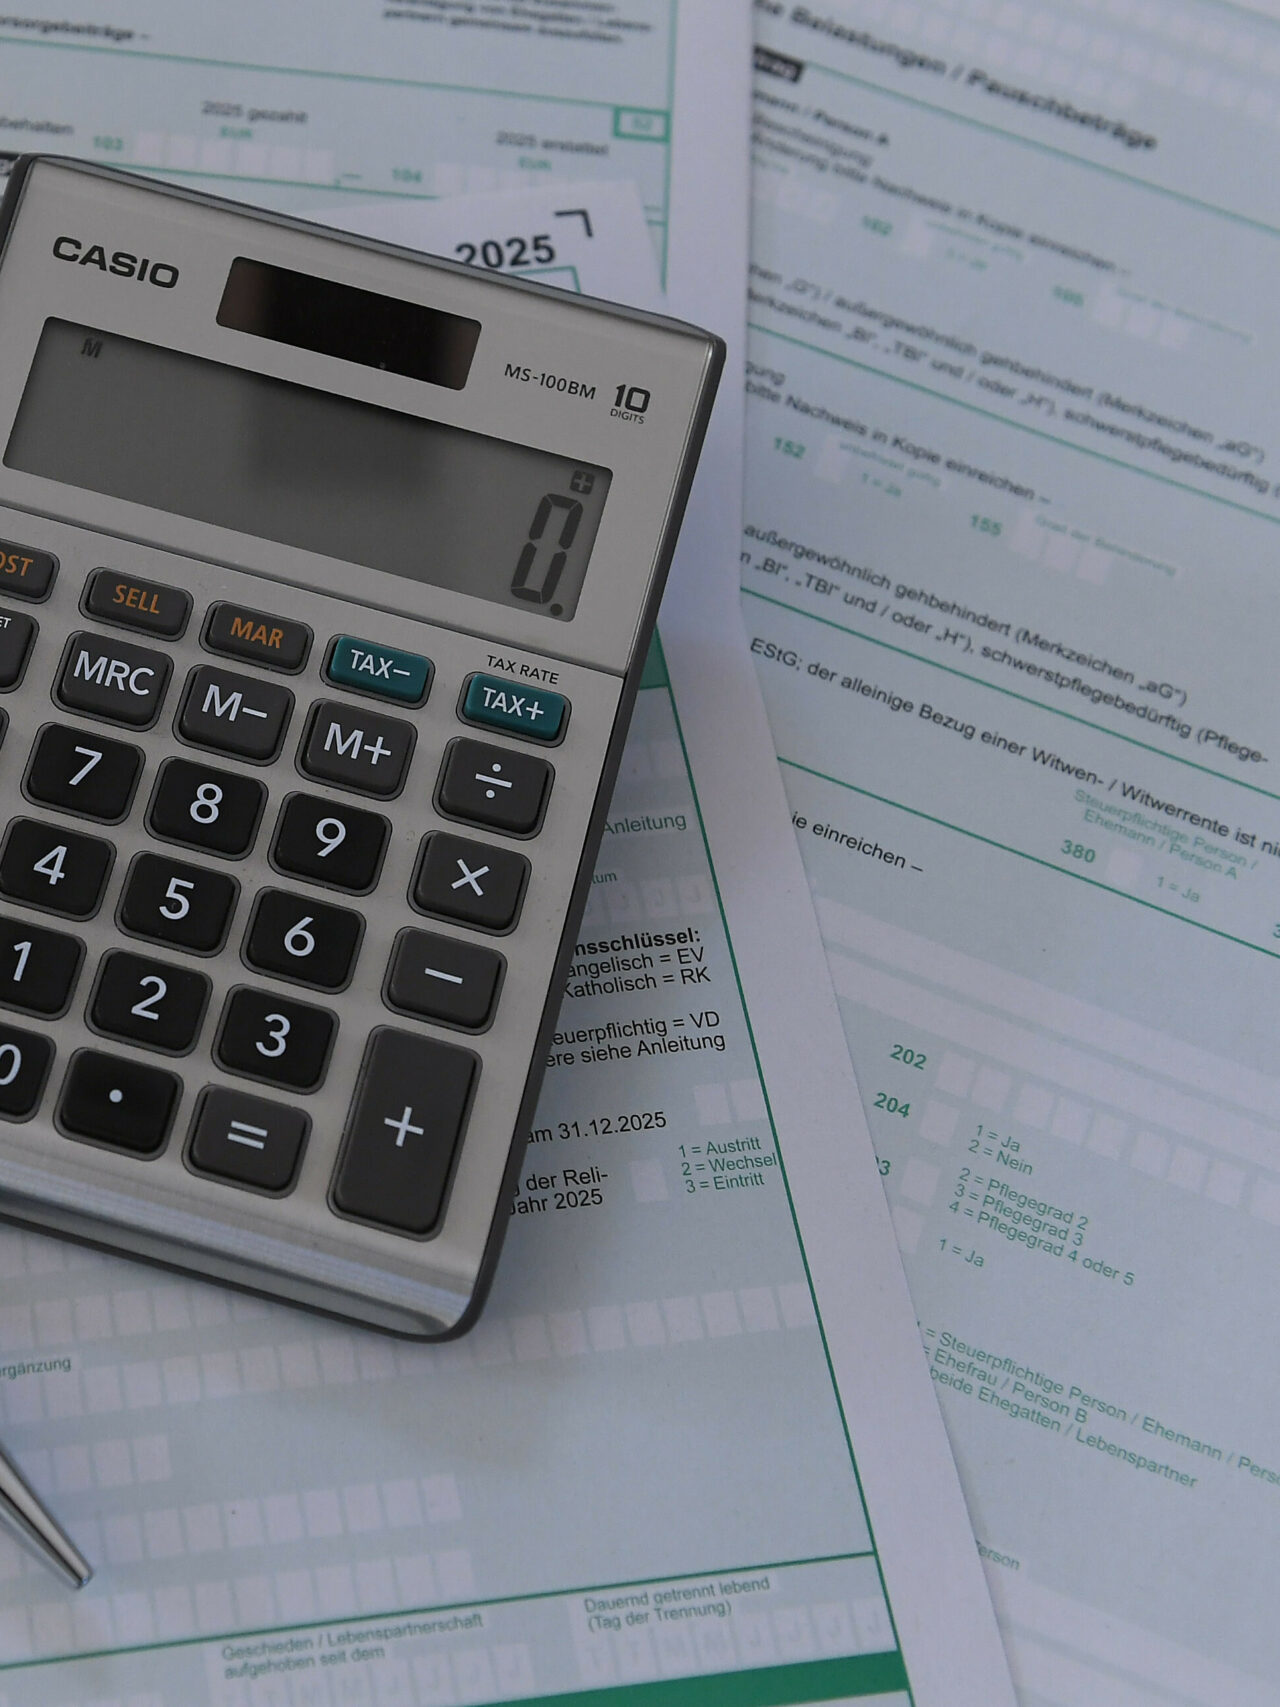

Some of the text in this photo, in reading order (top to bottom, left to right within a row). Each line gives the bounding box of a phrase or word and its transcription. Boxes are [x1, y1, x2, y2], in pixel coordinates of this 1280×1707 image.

[53, 237, 179, 288] CASIO
[454, 235, 555, 270] 2025
[81, 335, 104, 358] M
[505, 364, 596, 399] MS-100BM
[612, 383, 651, 413] 10
[609, 407, 647, 425] DIGITS
[113, 584, 162, 616] SELL
[230, 616, 284, 649] MAR
[73, 650, 154, 698] MRC
[486, 654, 559, 686] TAX RATE
[482, 687, 545, 720] TAX+
[749, 636, 1103, 784] EStG; der alleinige Bezug einer Witwen-
[323, 725, 392, 766] M+
[69, 746, 102, 785] 7
[190, 784, 222, 823] 8
[1121, 781, 1256, 847] Witwerrente ist
[316, 818, 346, 856] 9
[812, 823, 905, 868] einreichen
[1061, 839, 1095, 862] 380
[34, 846, 67, 884] 4
[160, 878, 194, 919] 5
[285, 917, 314, 956] 6
[14, 942, 31, 981] 1
[132, 976, 166, 1020] 2
[256, 1014, 290, 1056] 3
[580, 1035, 725, 1063] siehe Anleitung
[889, 1044, 926, 1070] 202
[873, 1092, 910, 1117] 204
[557, 1111, 666, 1139] 31.12.2025
[678, 1144, 685, 1158] 1
[706, 1136, 761, 1155] Austritt
[681, 1161, 691, 1176] 2
[707, 1150, 779, 1172] Wechsel
[685, 1172, 764, 1193] 3 = Eintritt
[958, 1167, 1088, 1230] 2 = Pflegegrad 2
